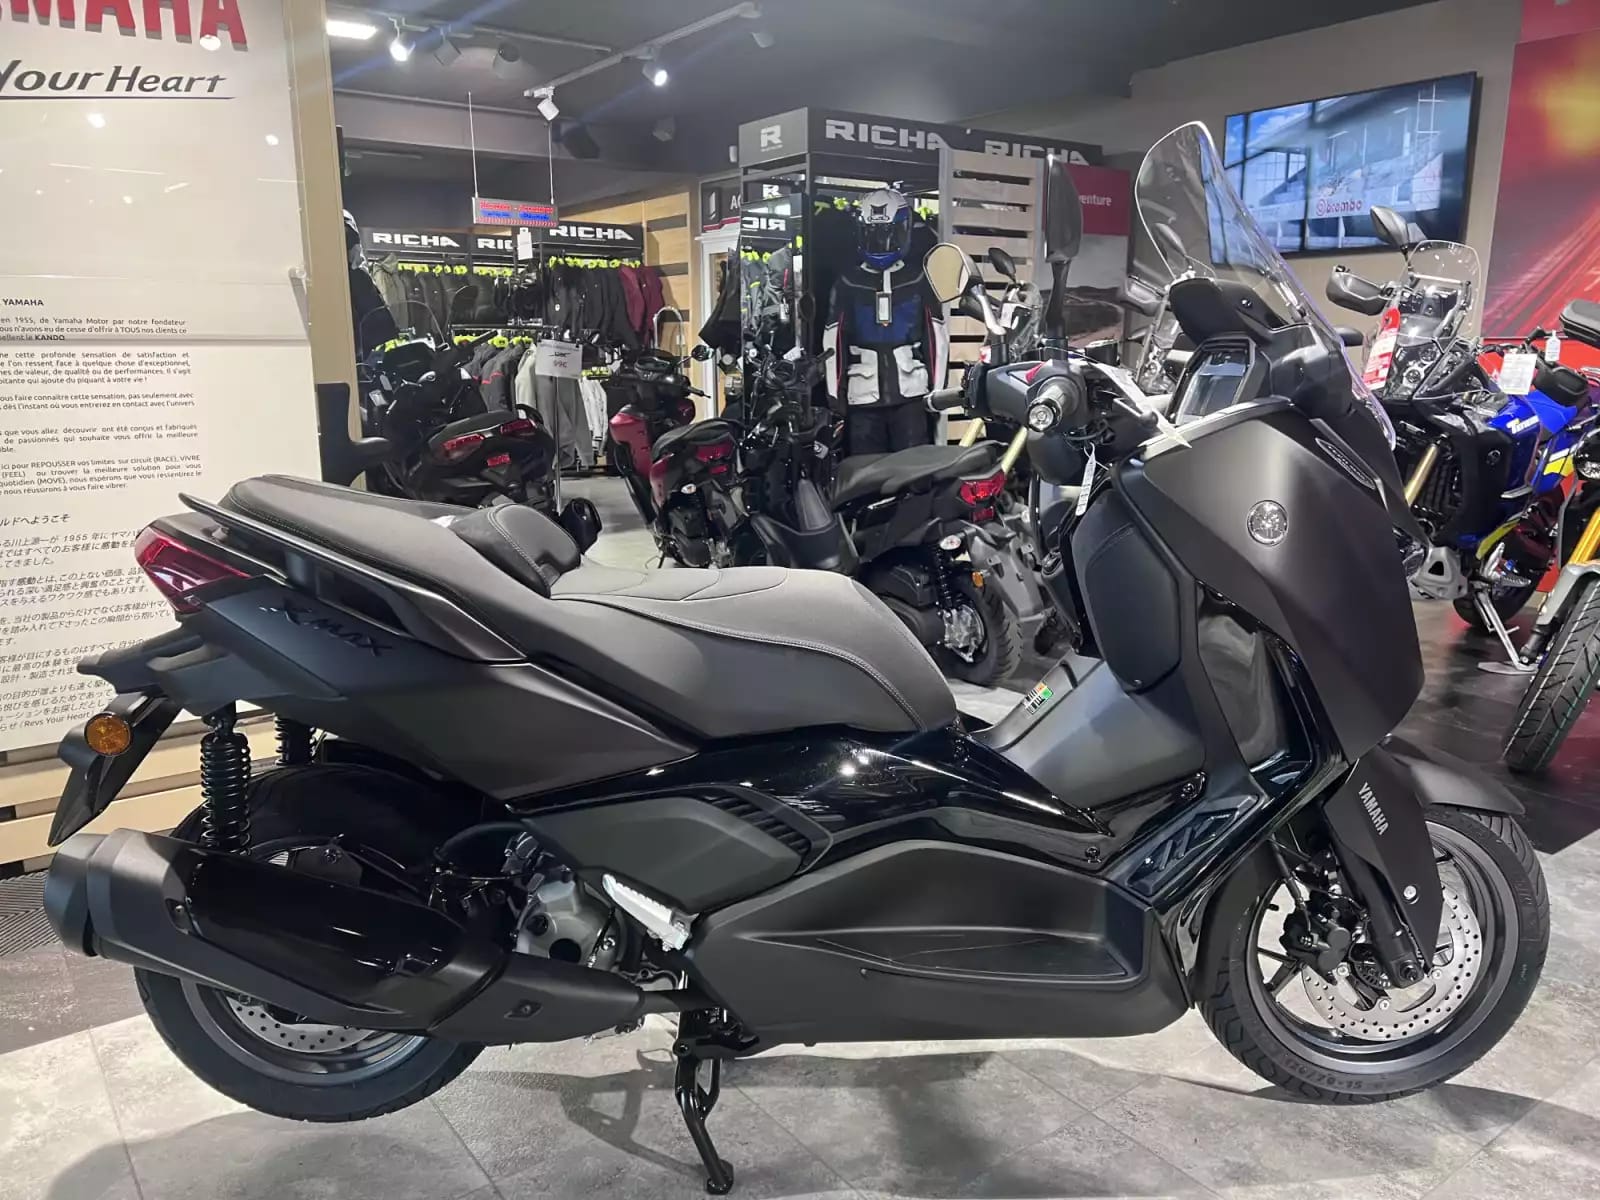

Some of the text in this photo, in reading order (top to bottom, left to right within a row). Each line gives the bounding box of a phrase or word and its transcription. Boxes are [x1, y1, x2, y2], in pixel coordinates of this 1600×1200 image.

[105, 65, 227, 93] Heart
[760, 124, 782, 148] R
[825, 119, 950, 149] RICHA
[372, 232, 460, 247] RICHA
[550, 224, 634, 241] RICHA
[2, 298, 44, 306] YAMAHA
[82, 360, 112, 368] quelque
[78, 377, 105, 385] piquant
[30, 460, 76, 468] REPOUSSER
[2, 471, 26, 479] (FEEL)
[1358, 781, 1389, 836] YAMAHA
